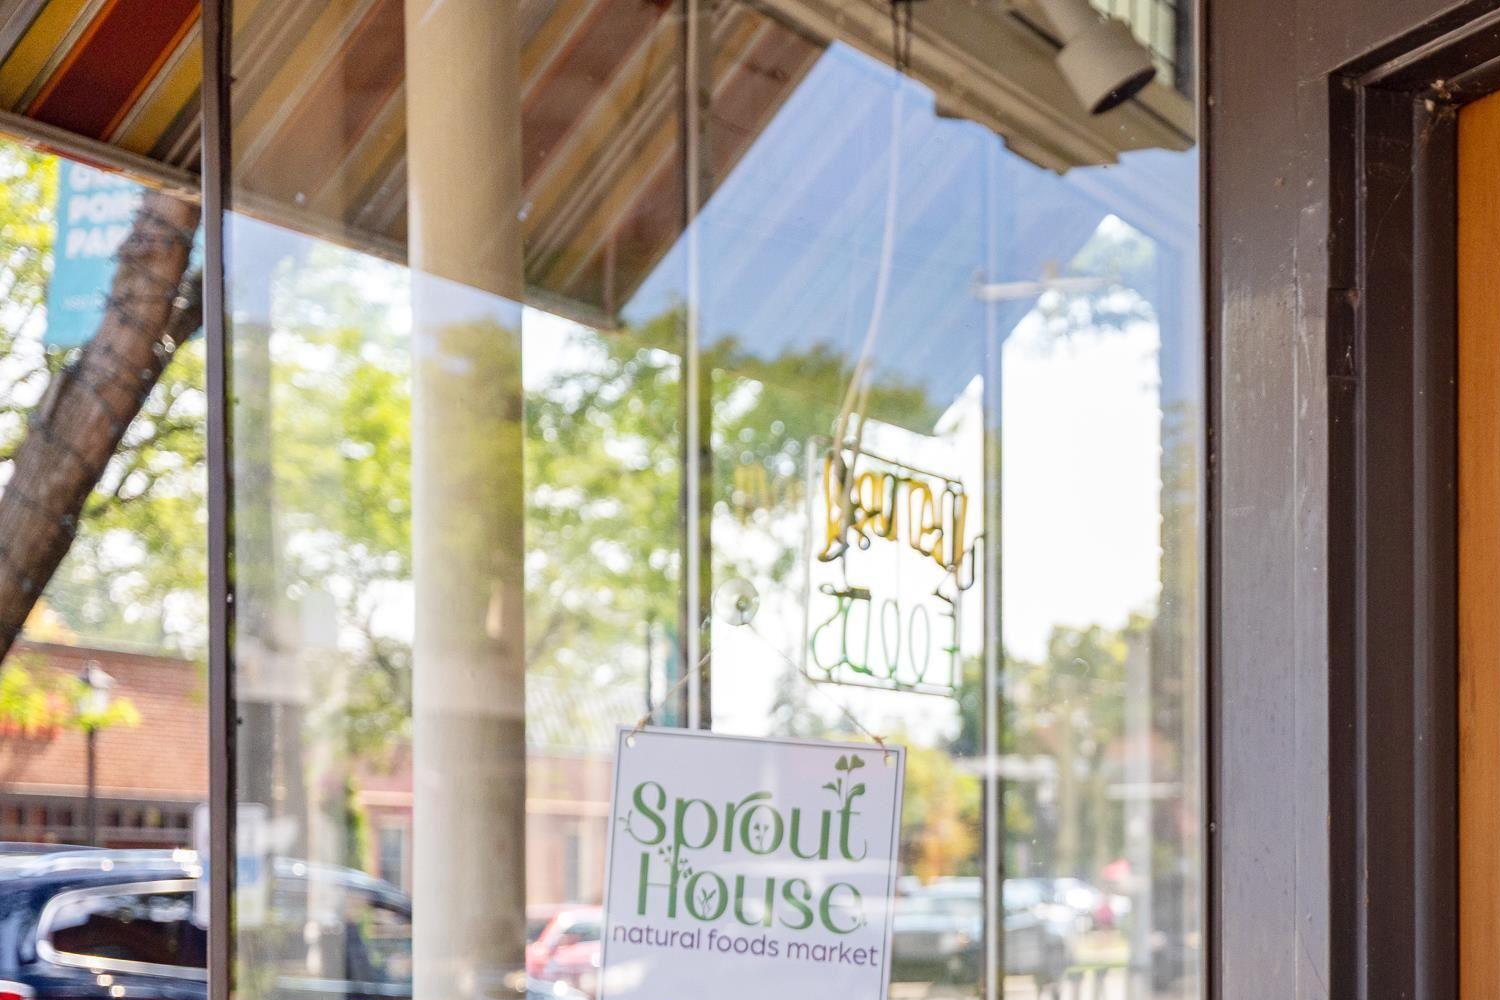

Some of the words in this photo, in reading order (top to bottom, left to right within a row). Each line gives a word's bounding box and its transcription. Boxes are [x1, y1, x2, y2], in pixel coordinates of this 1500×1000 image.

[620, 768, 868, 866] Sprout
[636, 852, 868, 936] House
[612, 925, 702, 951] natural
[707, 929, 780, 959] foods
[786, 940, 879, 967] market
